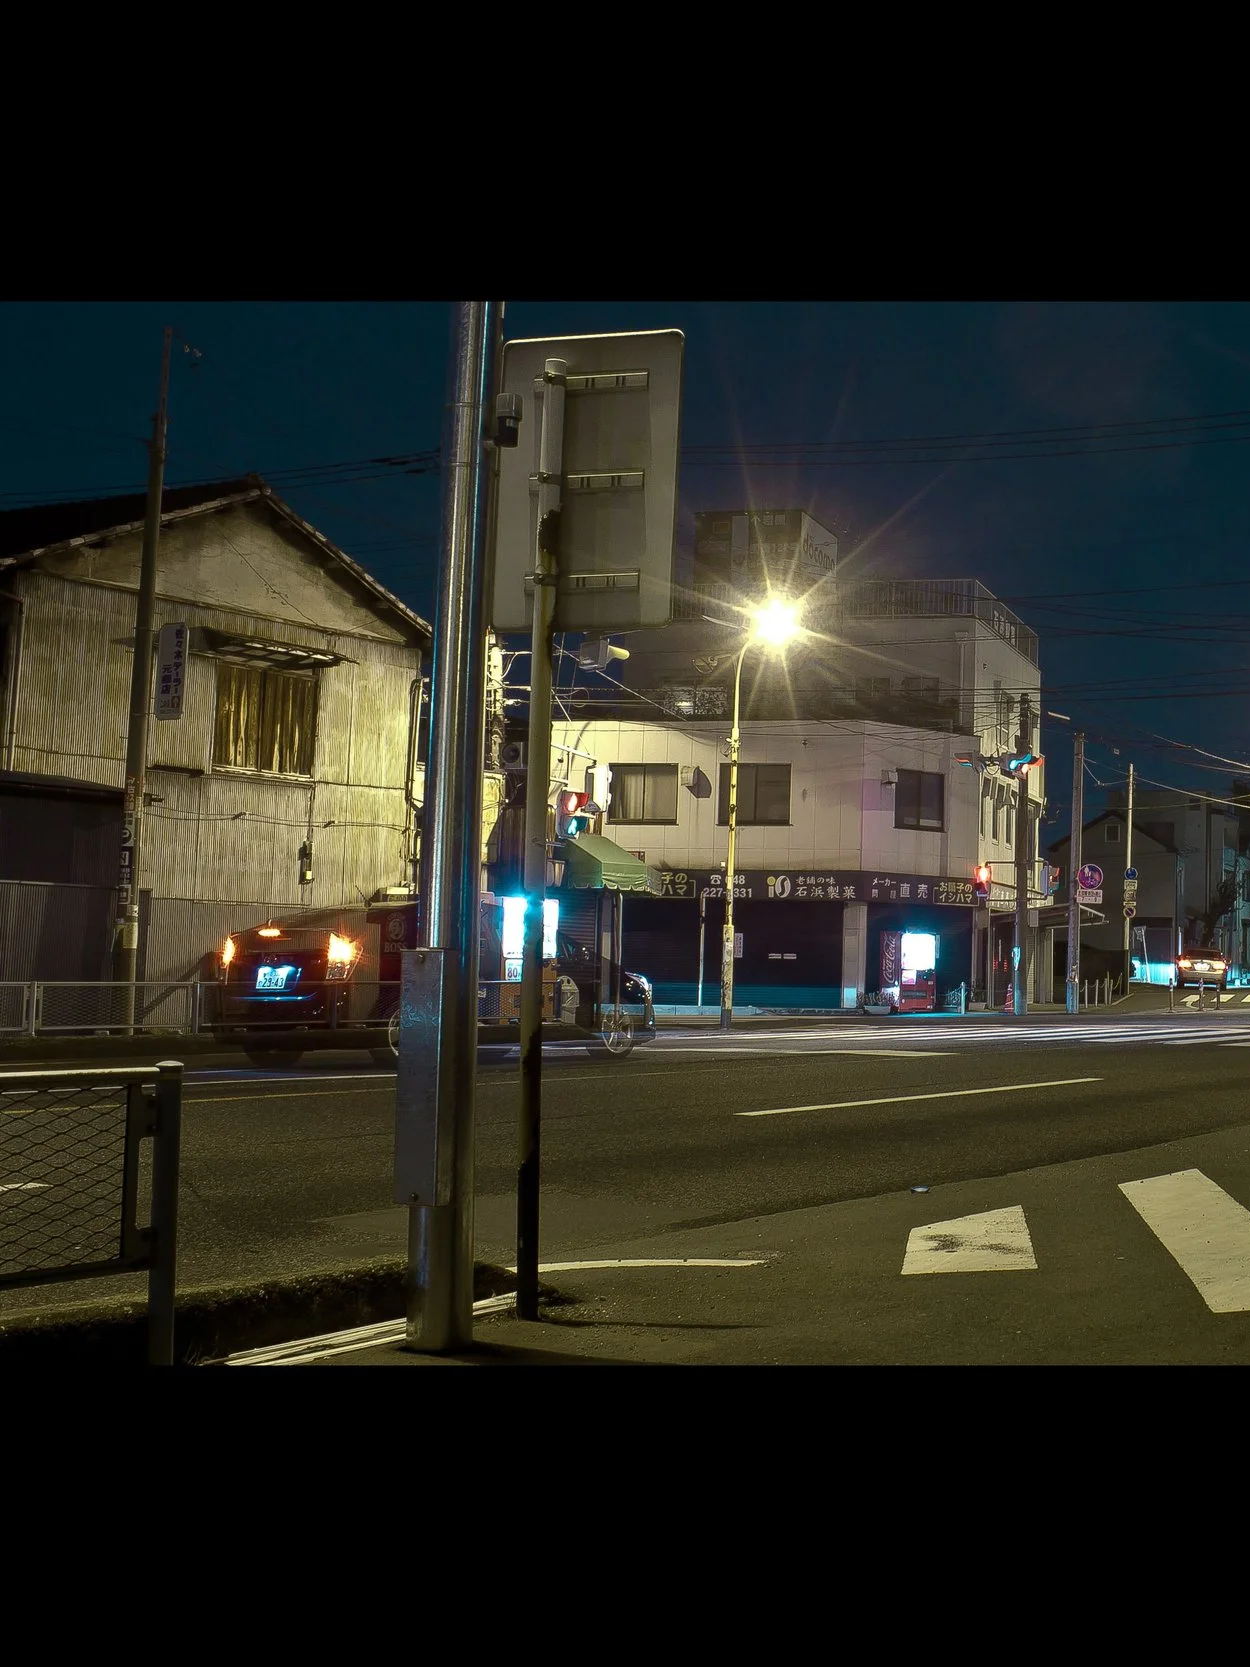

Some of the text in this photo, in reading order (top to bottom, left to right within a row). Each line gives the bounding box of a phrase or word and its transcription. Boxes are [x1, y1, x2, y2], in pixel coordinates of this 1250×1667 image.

[872, 877, 897, 887] メーカー
[703, 887, 752, 898] 227-331
[794, 885, 856, 899] 石浜製菓
[900, 883, 928, 899] 直売
[939, 892, 973, 903] イシハマ
